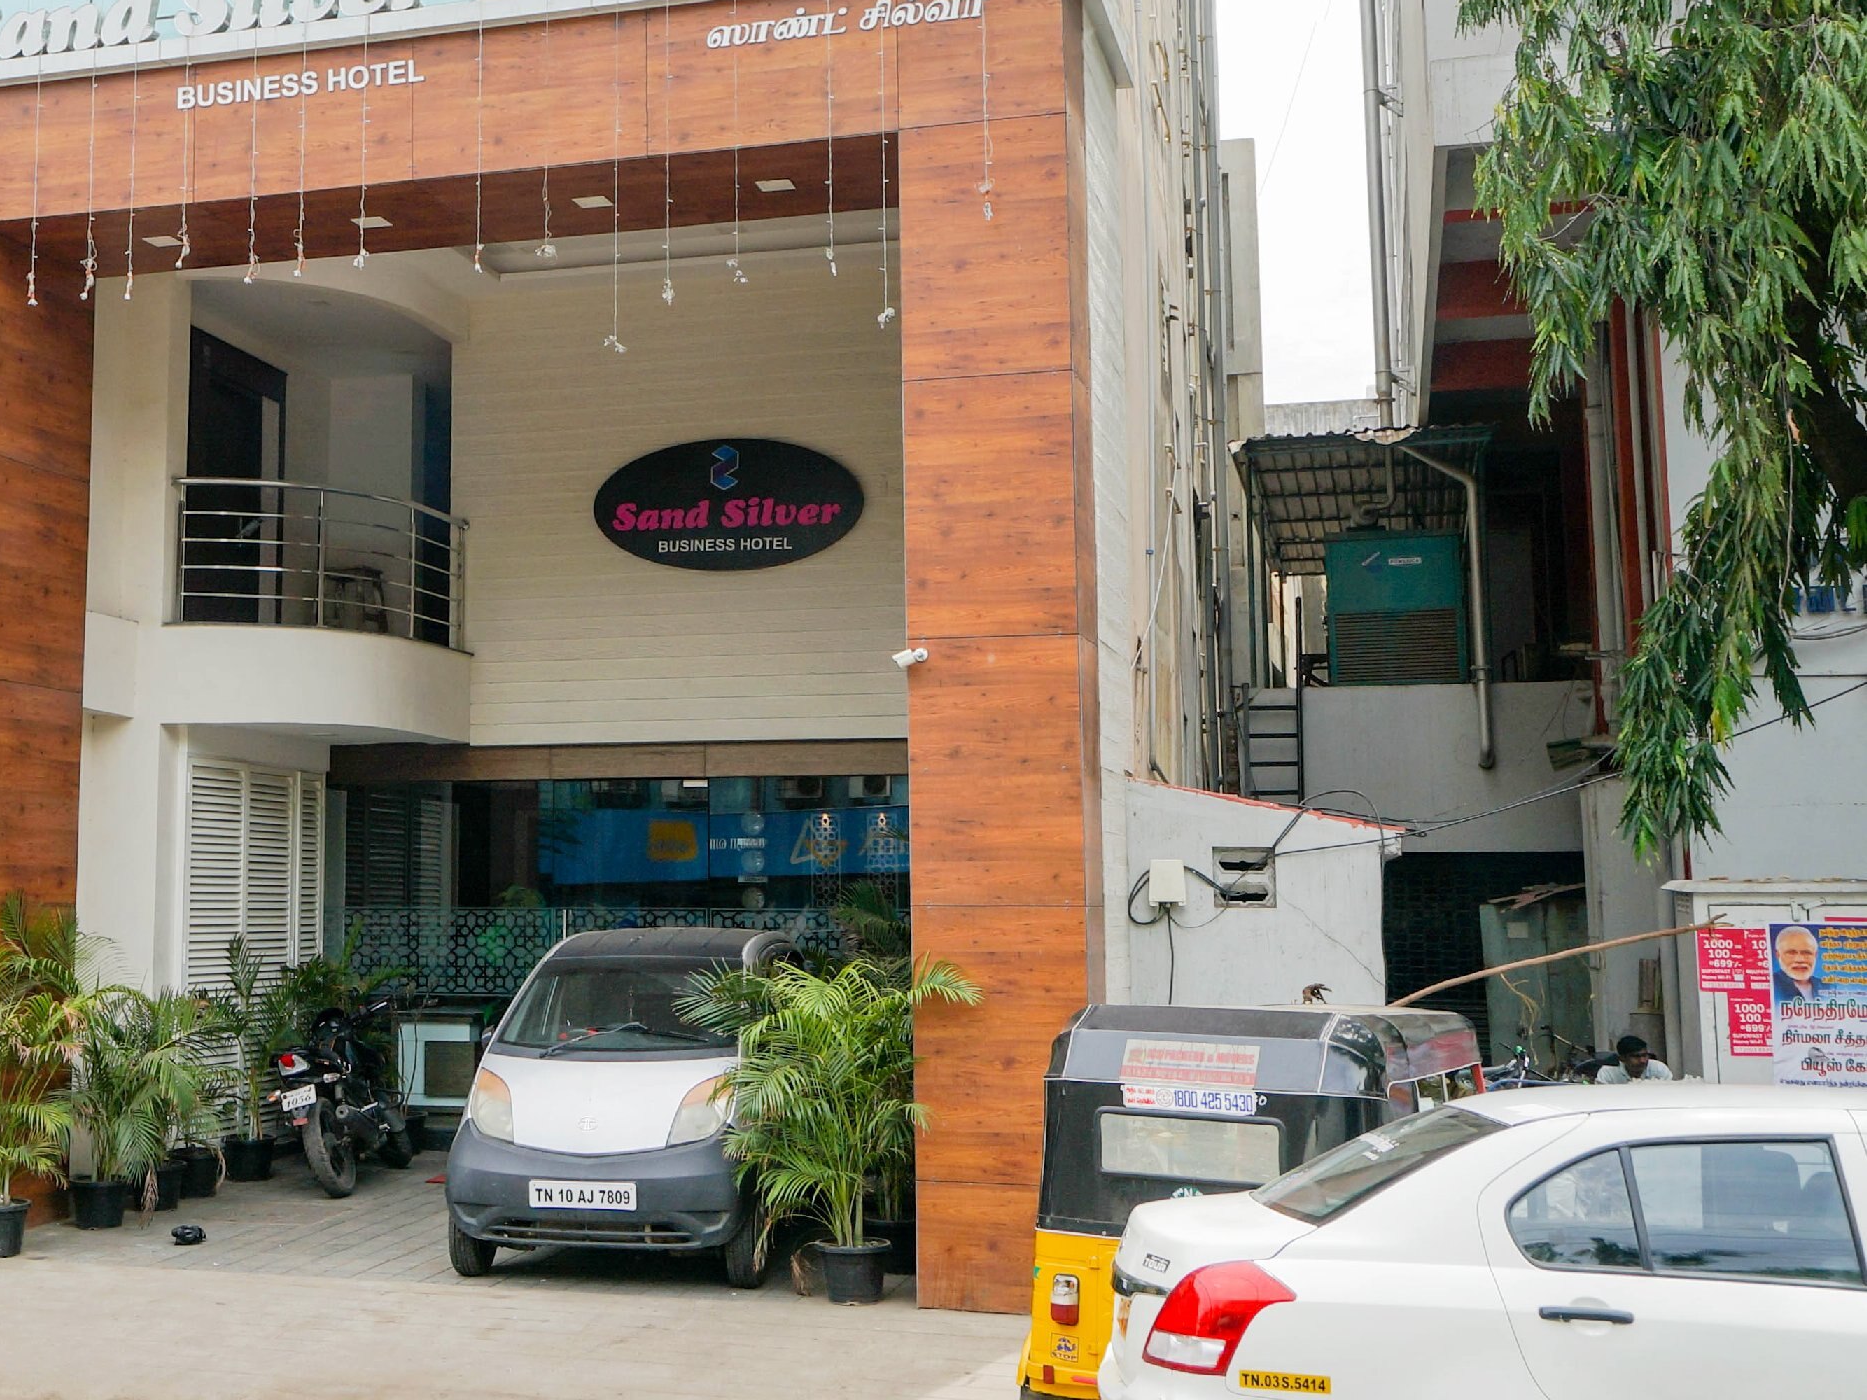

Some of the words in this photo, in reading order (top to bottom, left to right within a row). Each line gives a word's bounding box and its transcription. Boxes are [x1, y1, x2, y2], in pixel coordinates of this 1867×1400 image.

[176, 70, 319, 110] BUSINESS
[327, 59, 425, 92] HOTEL
[612, 498, 711, 531] Sand
[720, 496, 842, 529] Silver
[658, 537, 735, 553] BUSINESS
[740, 537, 793, 551] HOTEL
[1703, 939, 1733, 949] 1000
[1708, 949, 1731, 958] 100
[1734, 1003, 1765, 1013] 1000
[1739, 1013, 1762, 1023] 100
[1781, 1029, 1831, 1047] நிர்மலா
[1174, 1089, 1198, 1108] 1800
[1200, 1091, 1222, 1110] 425
[1224, 1093, 1253, 1112] 5430
[535, 1188, 553, 1202] TN
[558, 1188, 573, 1202] 10
[577, 1189, 594, 1204] AJ
[598, 1189, 630, 1205] 7809
[1051, 1351, 1077, 1360] STOP
[1241, 1373, 1326, 1392] TN.03S.5414
